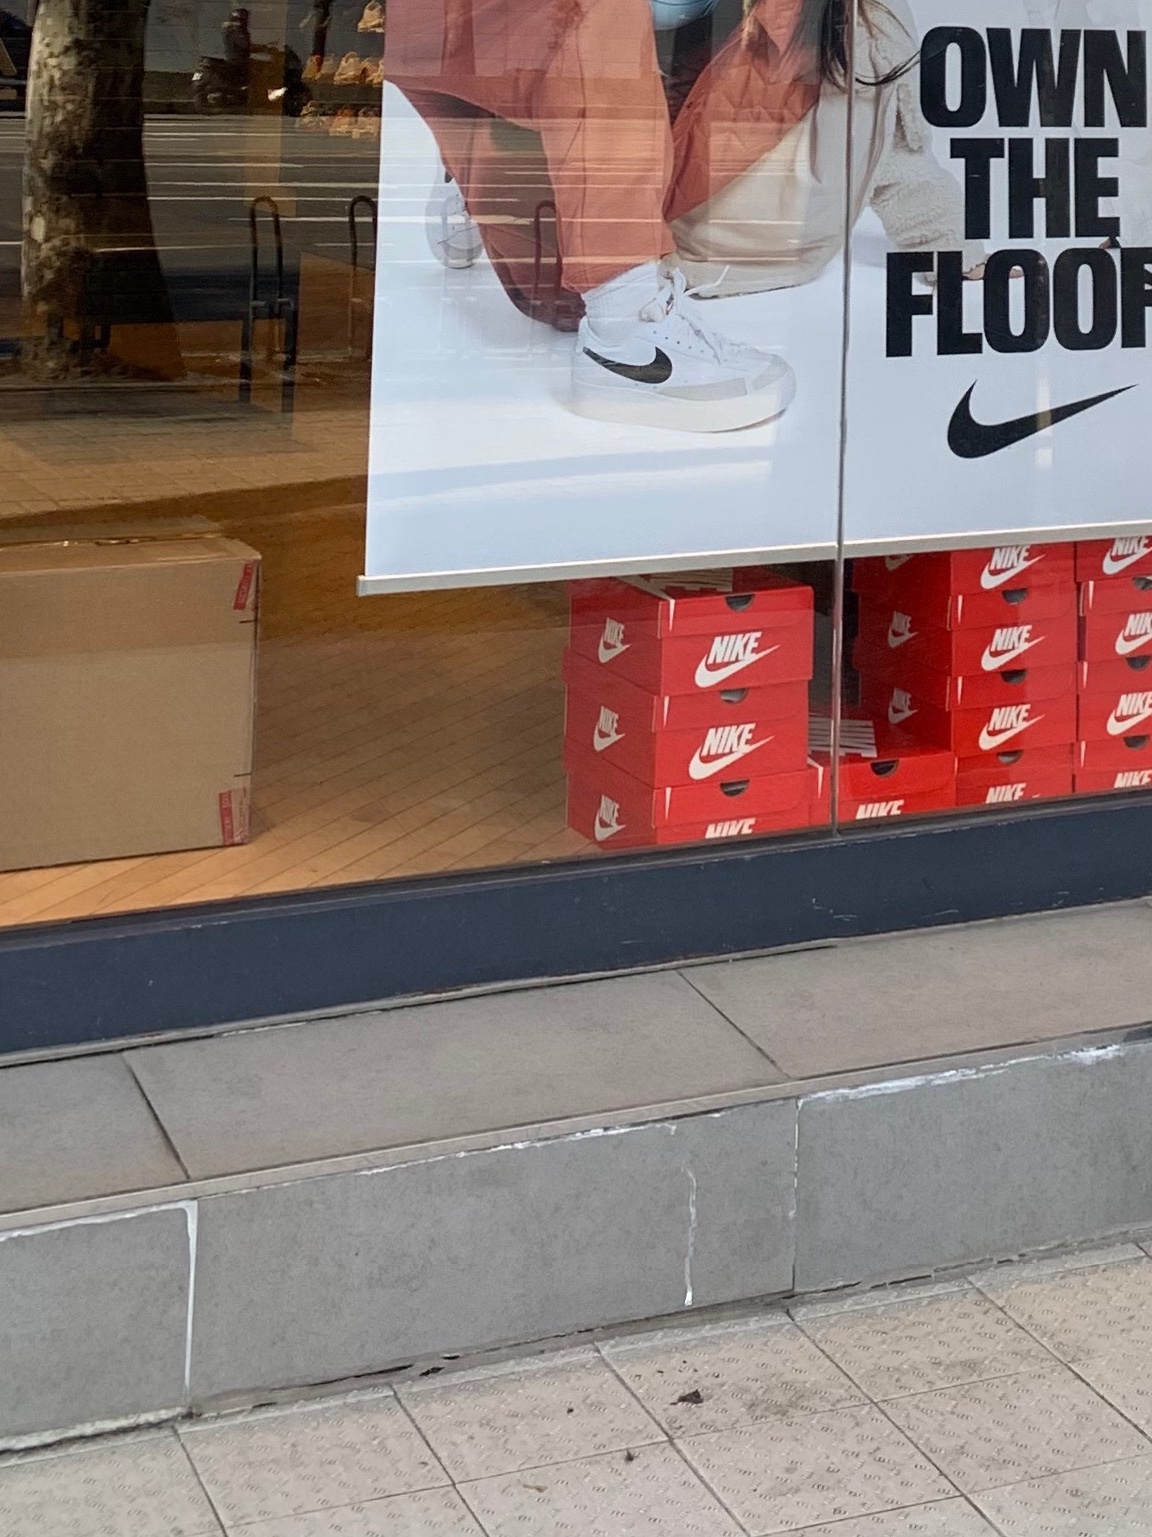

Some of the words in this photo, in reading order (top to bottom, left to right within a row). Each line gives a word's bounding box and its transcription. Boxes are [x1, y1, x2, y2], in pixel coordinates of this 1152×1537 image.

[919, 26, 1147, 128] OWN
[949, 137, 1120, 240] THE
[989, 545, 1032, 570] NIKE
[1112, 536, 1149, 556] NIKE
[706, 631, 762, 665] NIKE
[990, 625, 1032, 652] NIKE
[988, 704, 1031, 731] NIKE
[701, 723, 756, 757] NIKE
[1114, 770, 1152, 788] NIKE
[986, 783, 1026, 804] NIKE
